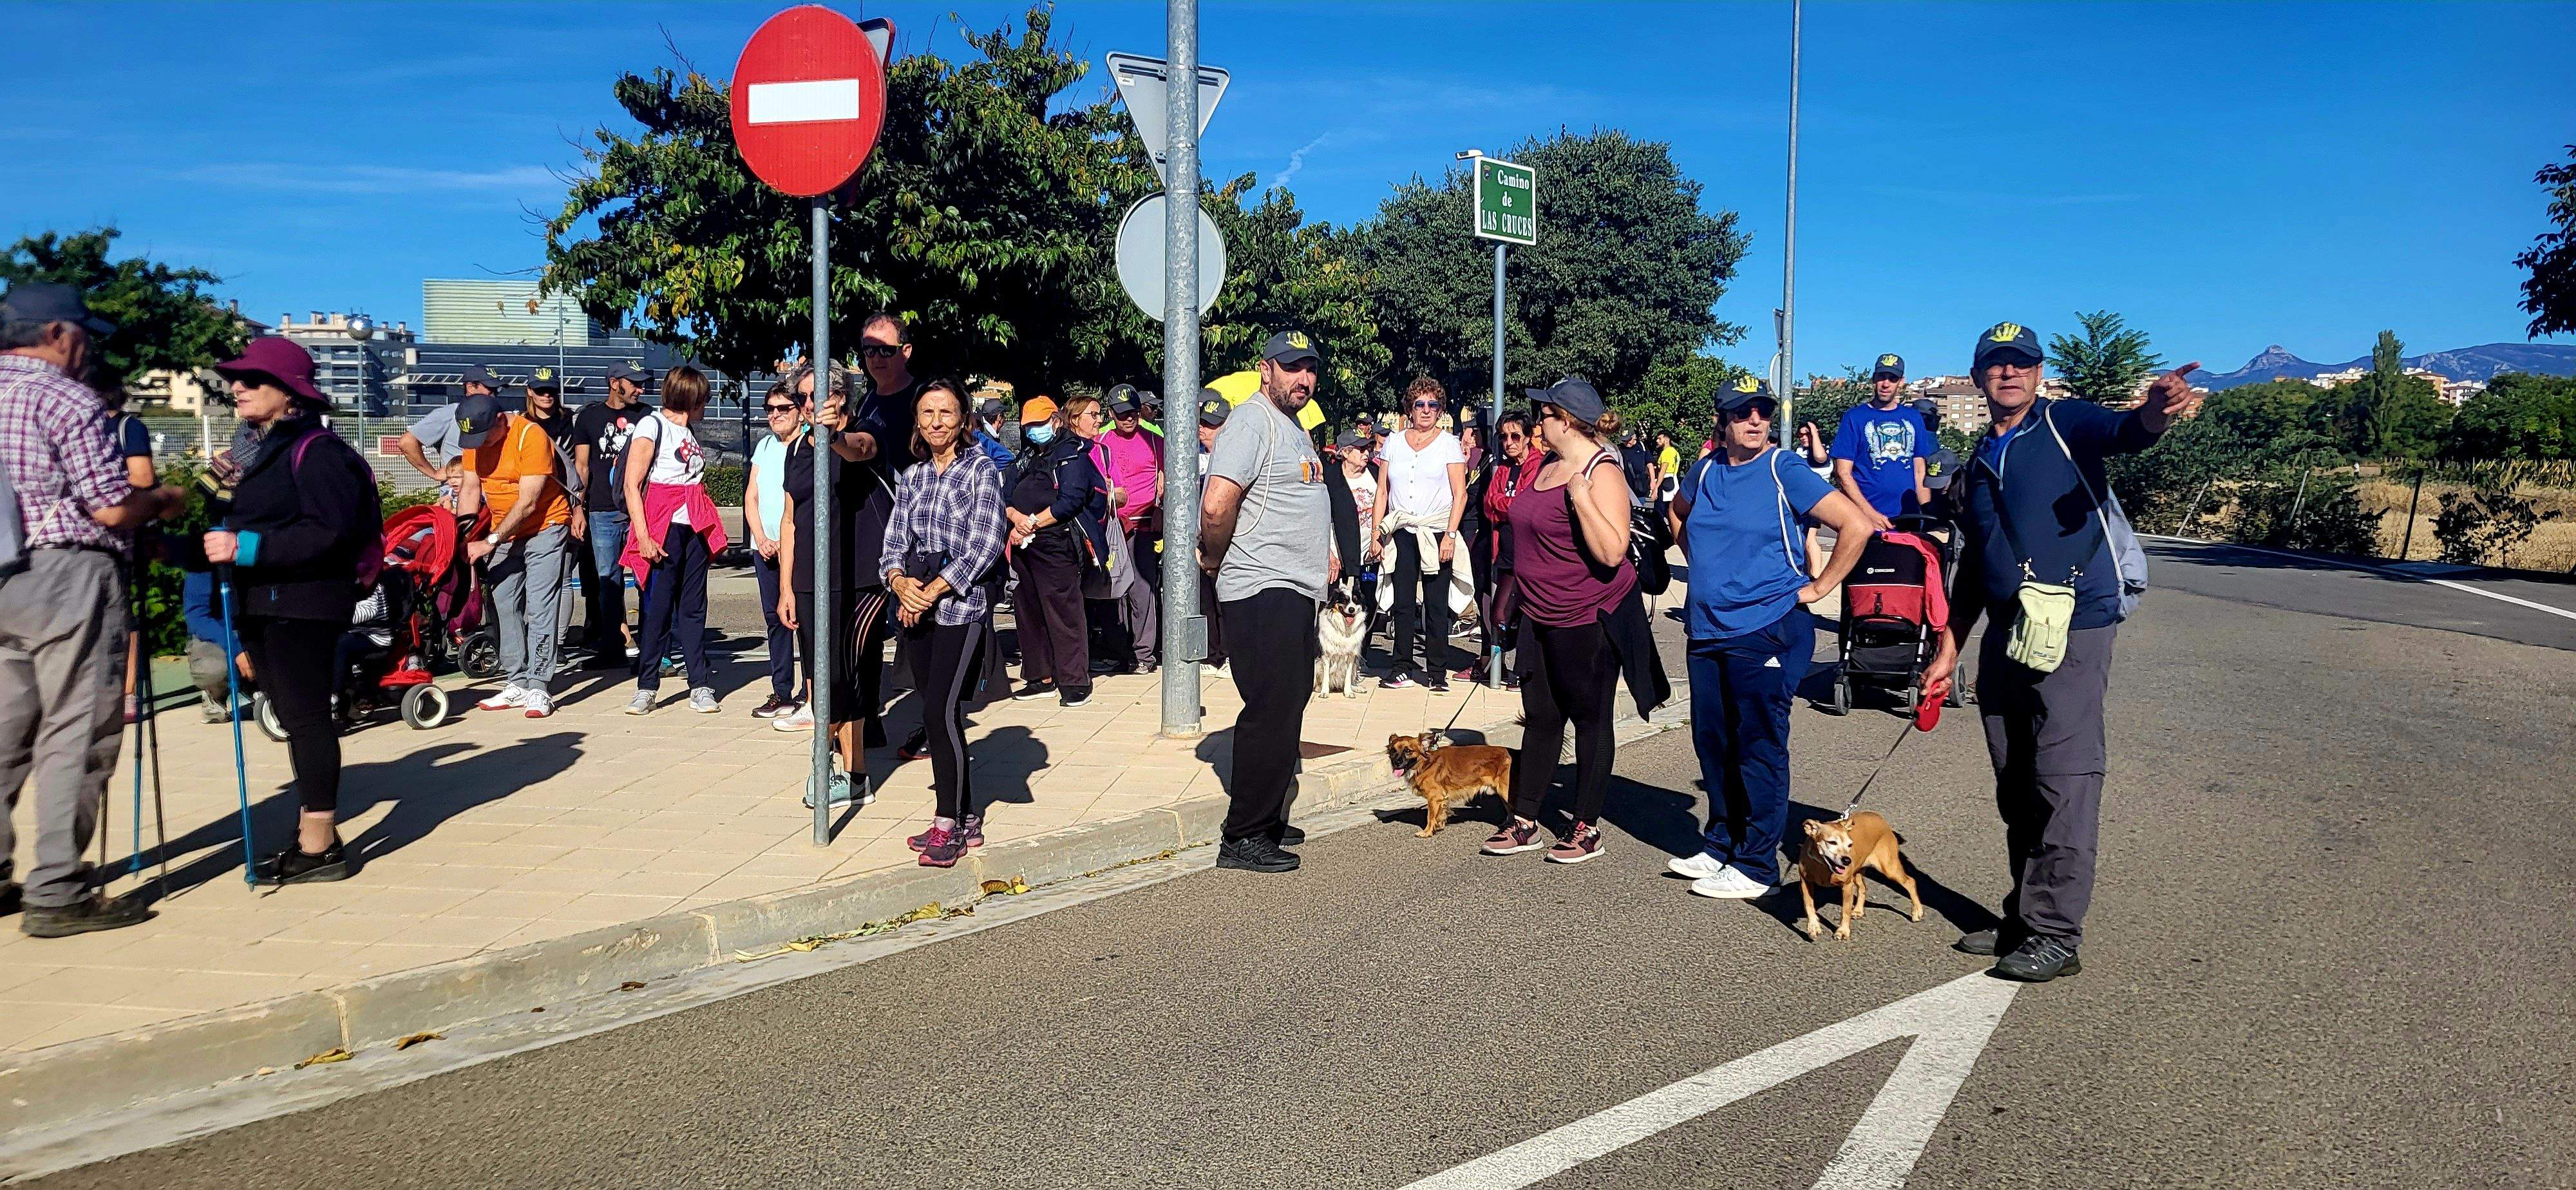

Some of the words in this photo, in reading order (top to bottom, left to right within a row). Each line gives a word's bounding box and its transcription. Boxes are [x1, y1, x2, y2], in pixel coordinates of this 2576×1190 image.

[1497, 169, 1530, 190] Camino
[1502, 191, 1513, 207] de
[1482, 209, 1497, 231] LAS
[1502, 212, 1532, 237] CRUCES
